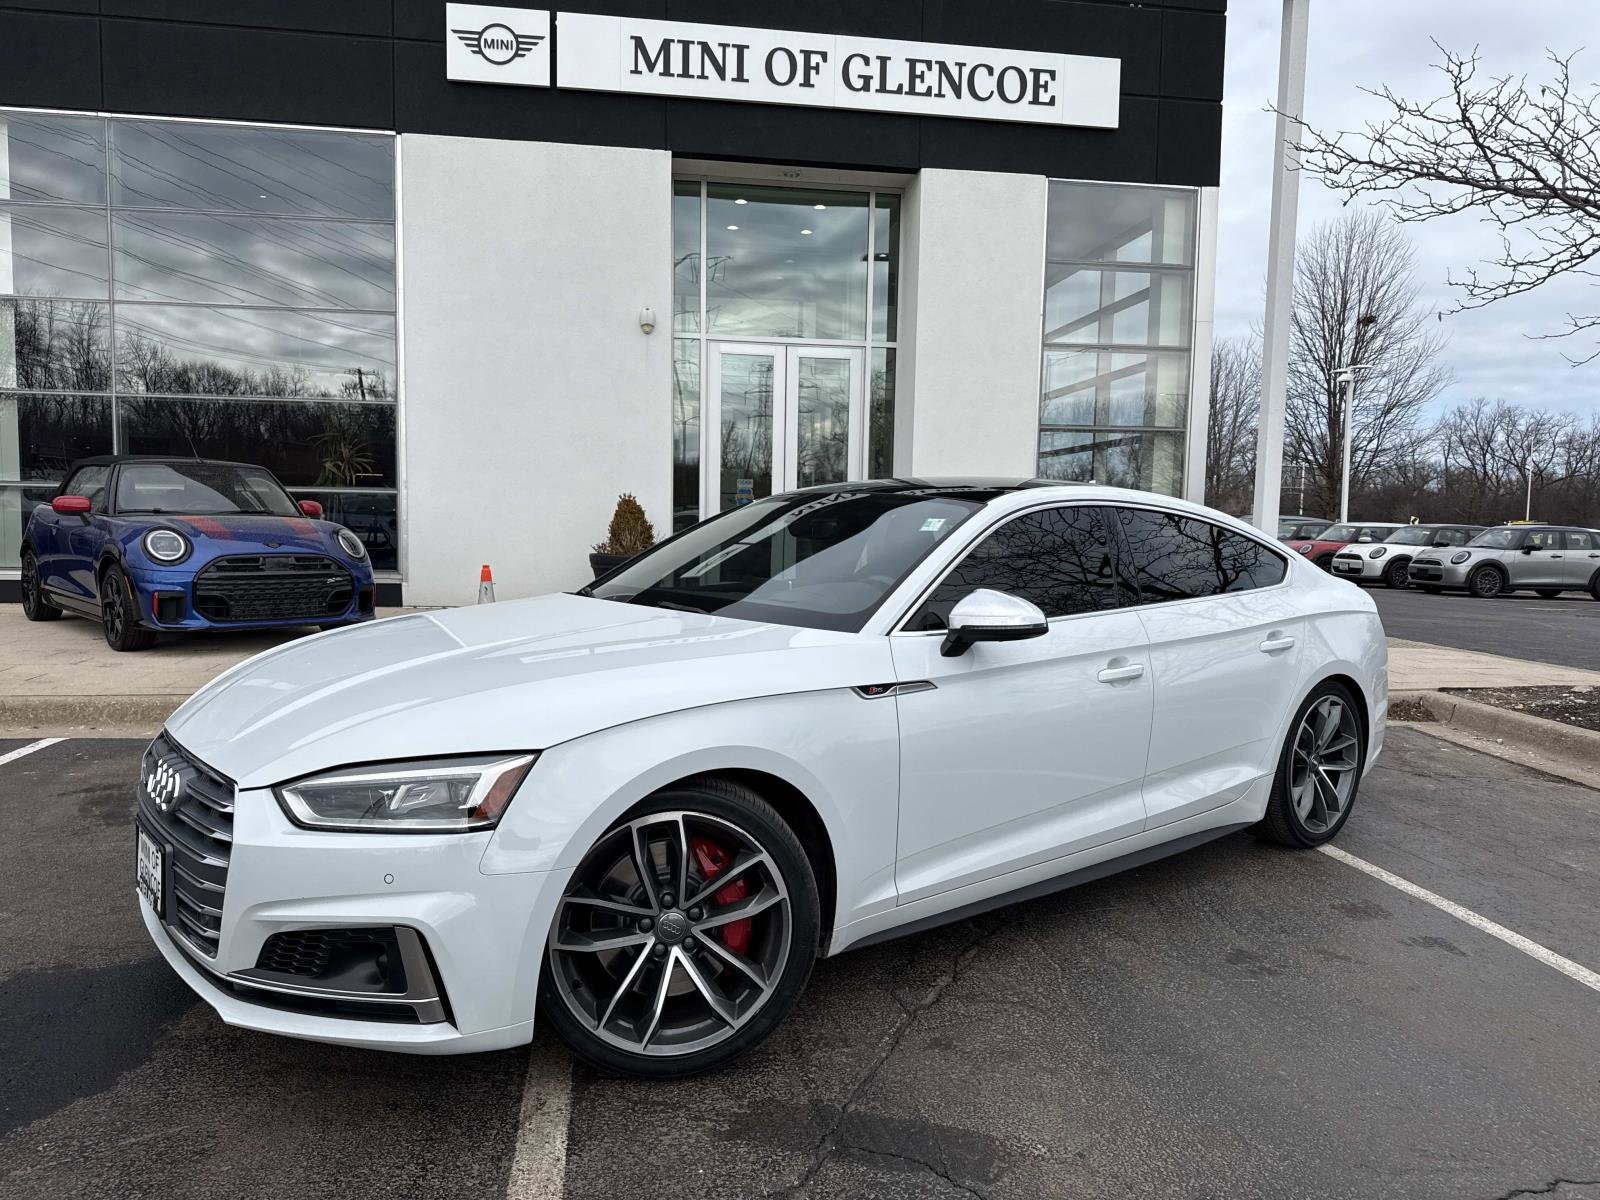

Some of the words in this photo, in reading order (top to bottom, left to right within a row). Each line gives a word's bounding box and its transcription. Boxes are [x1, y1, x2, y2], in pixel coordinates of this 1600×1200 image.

[483, 38, 513, 51] MINI
[630, 35, 749, 83] MINI
[765, 46, 828, 88] OF
[841, 53, 1057, 106] GLENCOE
